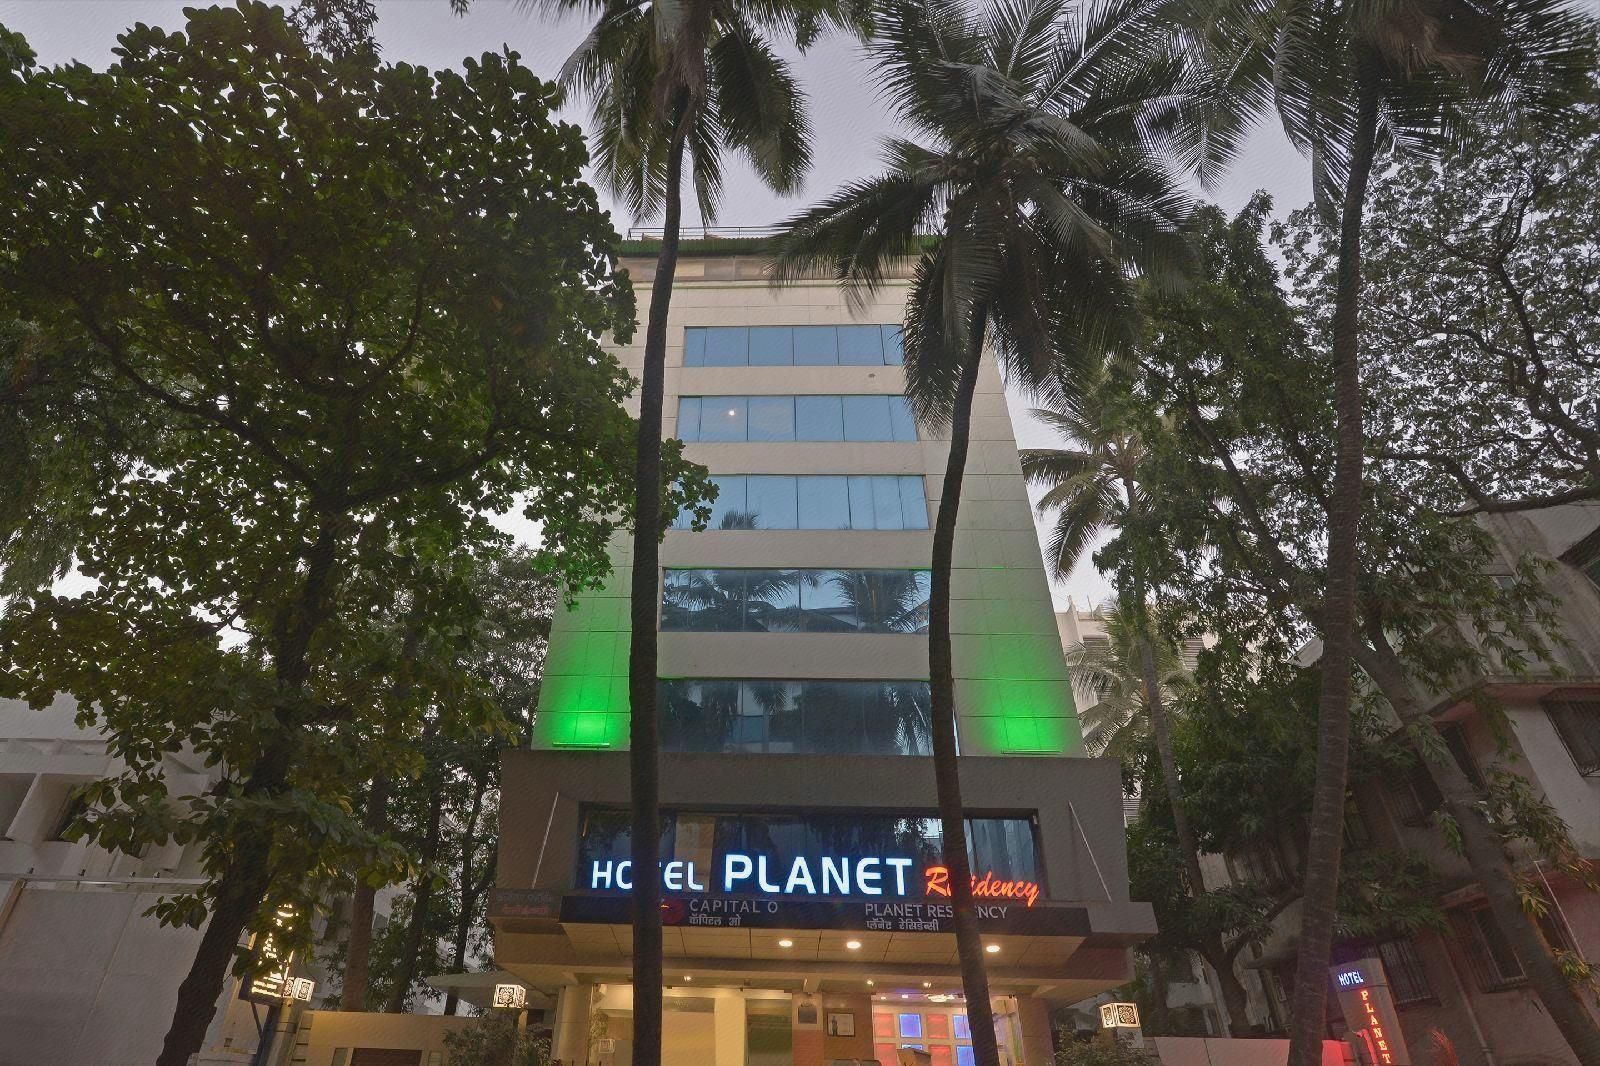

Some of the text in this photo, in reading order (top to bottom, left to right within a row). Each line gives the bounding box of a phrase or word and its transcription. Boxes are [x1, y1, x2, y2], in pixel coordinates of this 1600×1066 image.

[591, 854, 1040, 907] HOEL PLANET Ridency
[689, 899, 779, 914] CAPITAL O
[865, 903, 1009, 919] PLANET RESNCY
[1339, 971, 1364, 986] HOTEL
[1361, 990, 1391, 1064] PLANET
